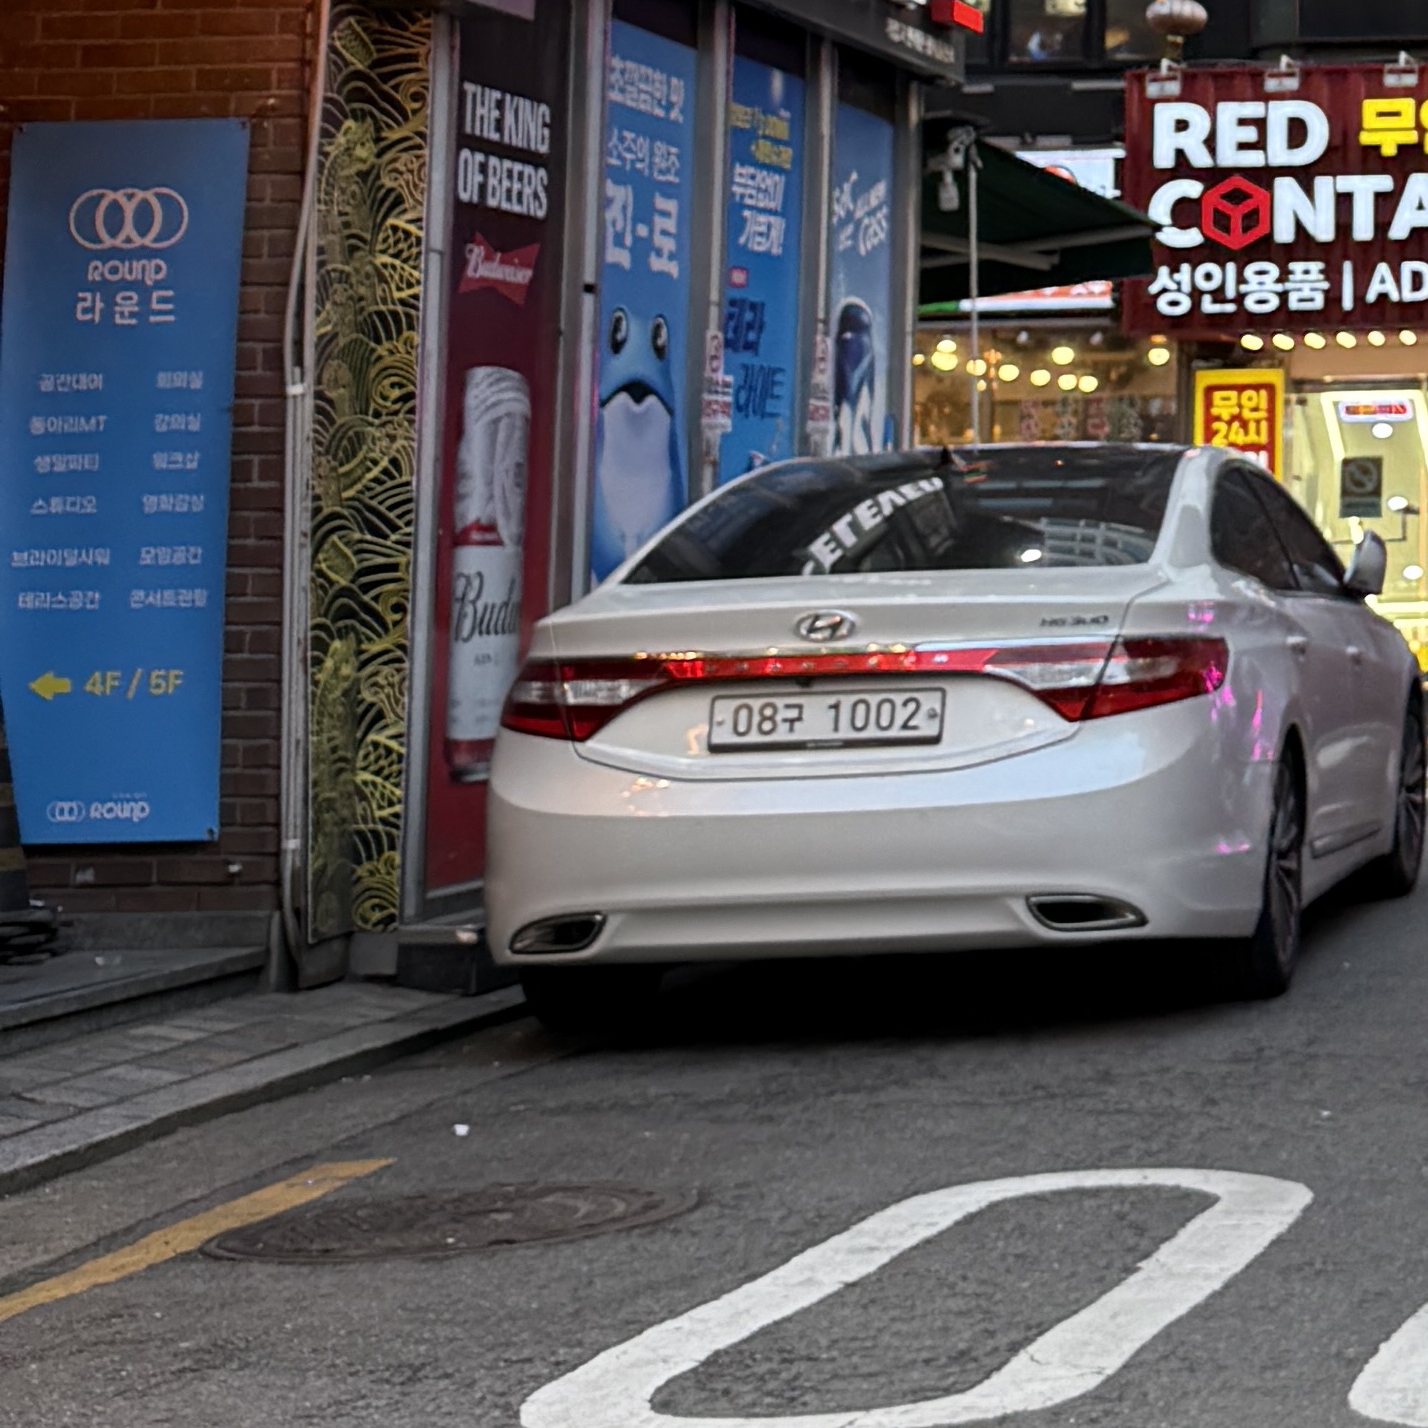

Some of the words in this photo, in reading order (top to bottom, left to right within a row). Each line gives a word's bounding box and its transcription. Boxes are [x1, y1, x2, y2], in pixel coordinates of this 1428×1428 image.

[463, 80, 501, 143] THE
[504, 93, 551, 154] KING
[1153, 100, 1330, 169] RED
[458, 148, 485, 204] OF
[487, 155, 548, 220] BEERS
[87, 259, 167, 285] ROUND
[1148, 261, 1329, 316] 성인용품
[1211, 389, 1268, 421] 무인
[1211, 420, 1268, 447] 24시
[30, 495, 97, 514] 스튜디오
[84, 671, 122, 696] 4F
[150, 669, 184, 695] 5F
[732, 702, 804, 737] 08구
[827, 696, 922, 733] 1002
[89, 802, 150, 822] ROUND
